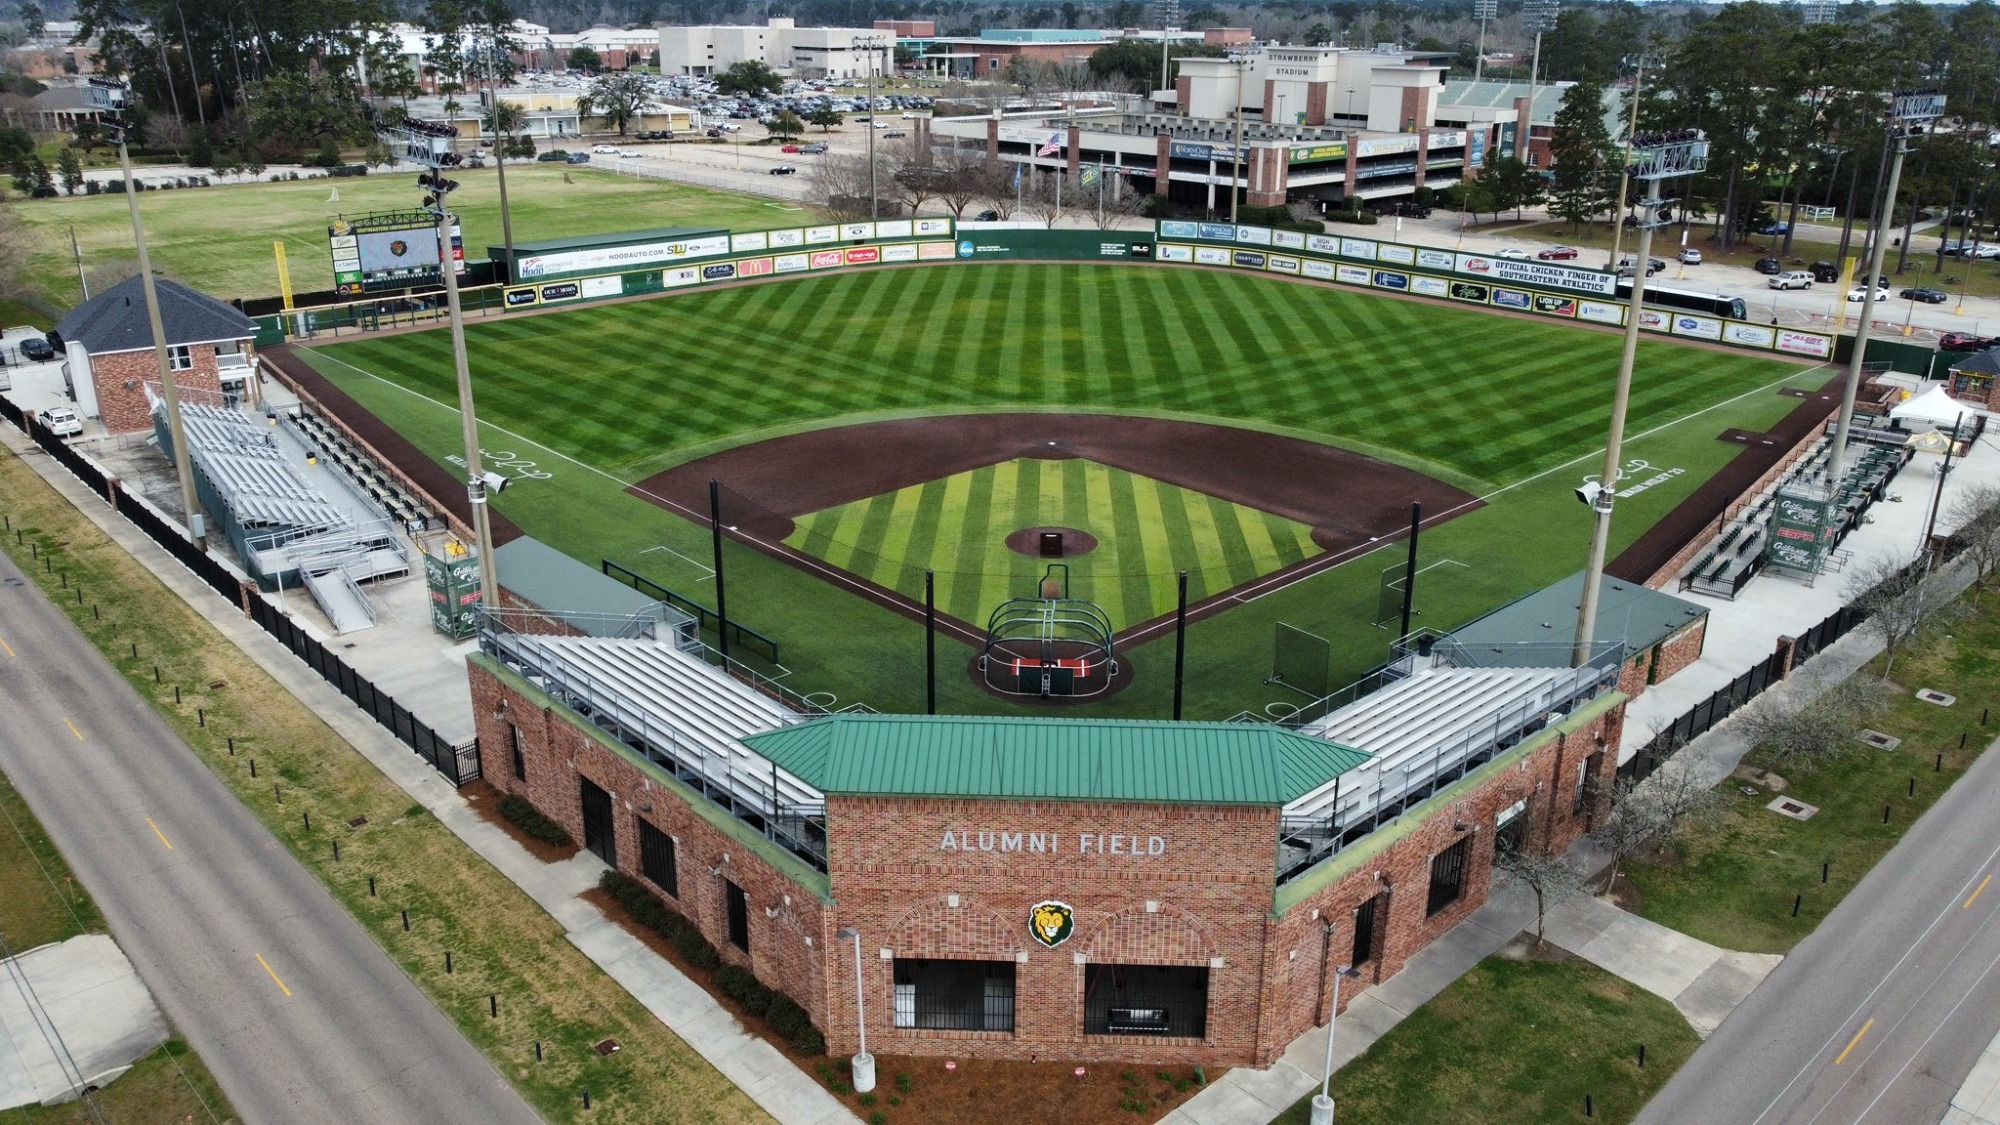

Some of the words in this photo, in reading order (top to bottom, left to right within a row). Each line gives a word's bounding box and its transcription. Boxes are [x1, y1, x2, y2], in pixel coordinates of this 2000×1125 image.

[1269, 54, 1318, 62] STRAWBERRY
[1316, 237, 1330, 245] SIGN
[1312, 242, 1334, 251] WORLD
[608, 249, 664, 261] HOODAUTO.COM
[1235, 255, 1264, 263] COURTYARD
[1495, 261, 1529, 273] OFFICIAL
[1531, 265, 1565, 277] CHICKEN
[1567, 270, 1597, 282] FINGER
[1599, 275, 1610, 283] OF
[1499, 270, 1560, 286] SOUTHEASTERN
[1562, 279, 1604, 292] ATHLETICS
[1539, 296, 1553, 304] LION
[1553, 298, 1562, 306] UP
[1792, 335, 1823, 344] ALERT
[1778, 527, 1816, 542] ESPN
[940, 830, 1058, 854] ALUMNI
[1079, 833, 1167, 856] FIELD
